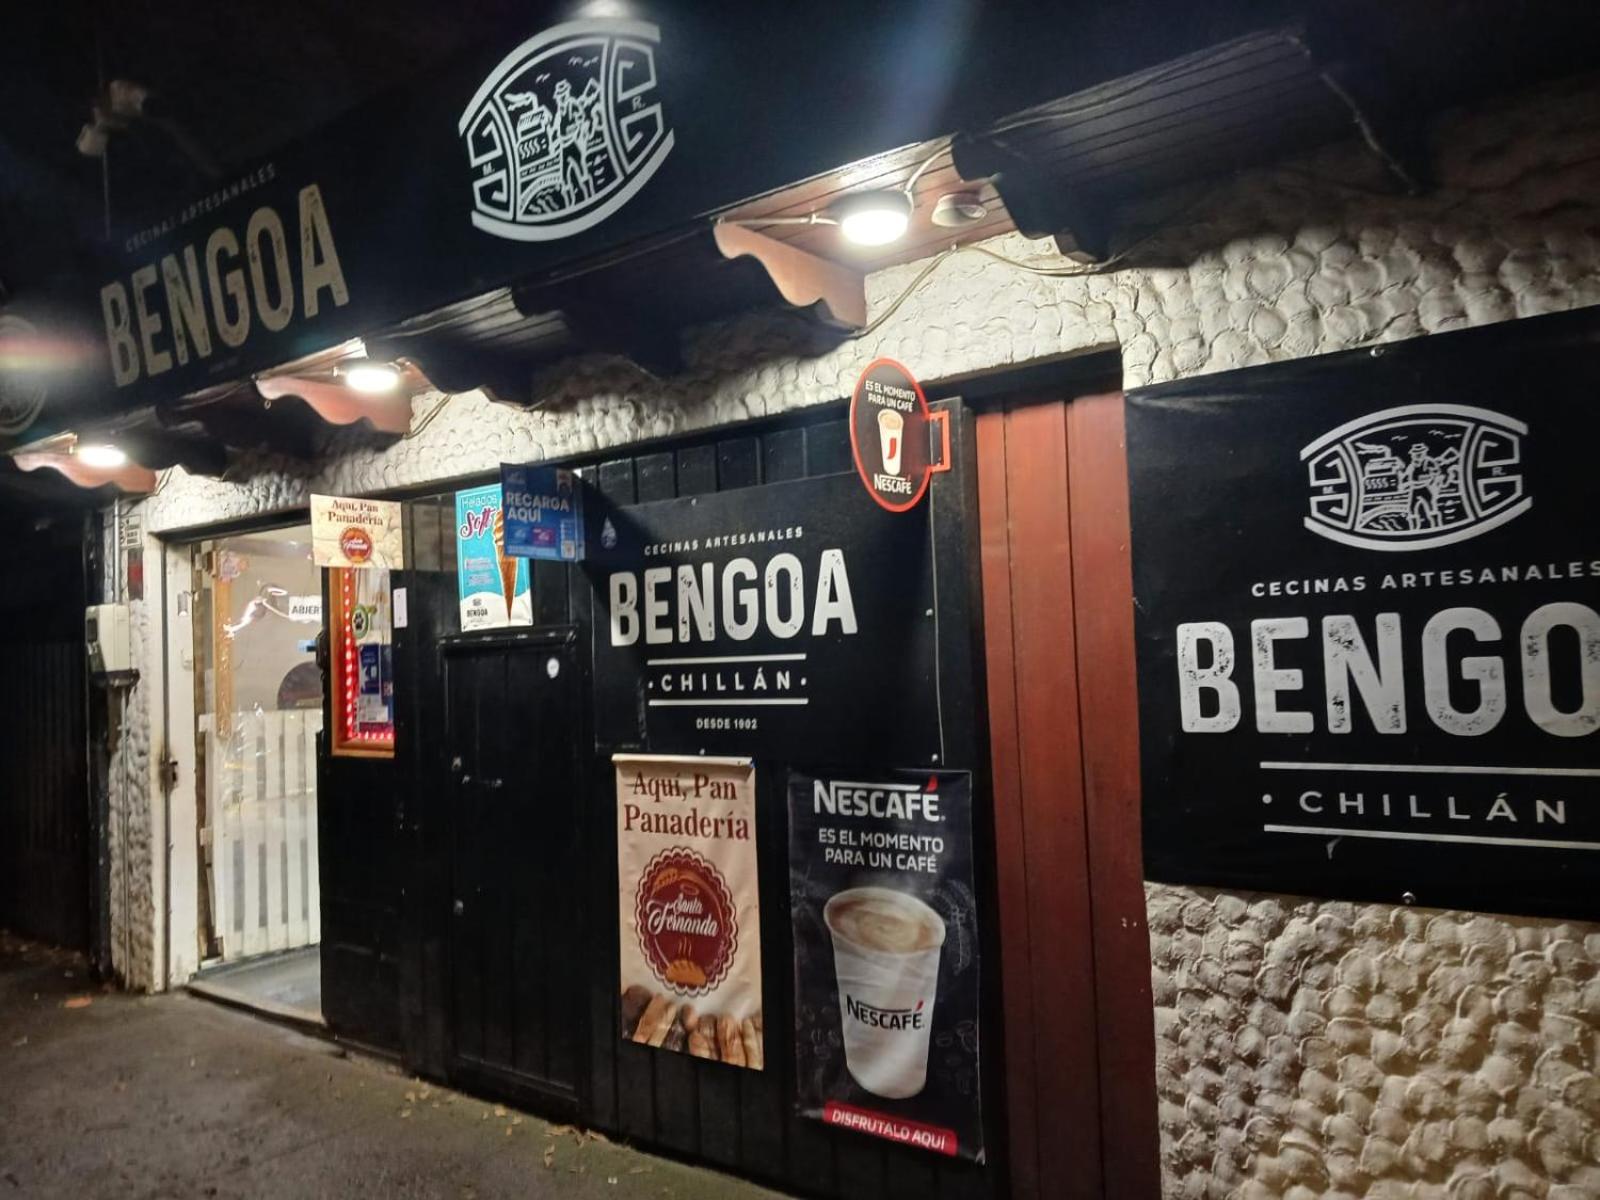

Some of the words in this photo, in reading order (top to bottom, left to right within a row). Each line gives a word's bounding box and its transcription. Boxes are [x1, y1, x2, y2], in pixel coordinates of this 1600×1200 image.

[100, 183, 350, 388] BENGOA
[865, 380, 874, 391] ES
[874, 382, 883, 394] EL
[883, 384, 916, 402] MOMENTO
[867, 392, 886, 406] PARA
[886, 397, 897, 408] UN
[873, 472, 913, 495] NESCAFÉ
[360, 503, 379, 513] Pan
[506, 491, 570, 513] RECARGA
[460, 506, 497, 538] Soft
[643, 538, 699, 556] CECINAS
[705, 526, 804, 550] ARTESANALES
[1250, 576, 1367, 598] CECINAS
[1380, 560, 1600, 590] ARTESANALES
[609, 548, 858, 647] BENGOA
[660, 666, 791, 692] CHILLÁN
[695, 717, 731, 730] DESDE
[633, 770, 688, 803] Aquí,
[693, 772, 738, 801] Pan
[813, 775, 941, 822] NESCAFÉ
[623, 803, 750, 840] Panadería
[1299, 790, 1567, 825] CHILLÁN
[818, 827, 836, 844] ES
[839, 829, 858, 846] EL
[860, 831, 945, 853] MOMENTO
[824, 847, 866, 867] PARA
[868, 851, 892, 869] UN
[895, 854, 938, 873] CAFÉ
[646, 899, 719, 938] Fernanda
[673, 892, 703, 915] Santa
[846, 993, 924, 1031] NESCAFÉ
[831, 1108, 910, 1140] DISFRUTALO
